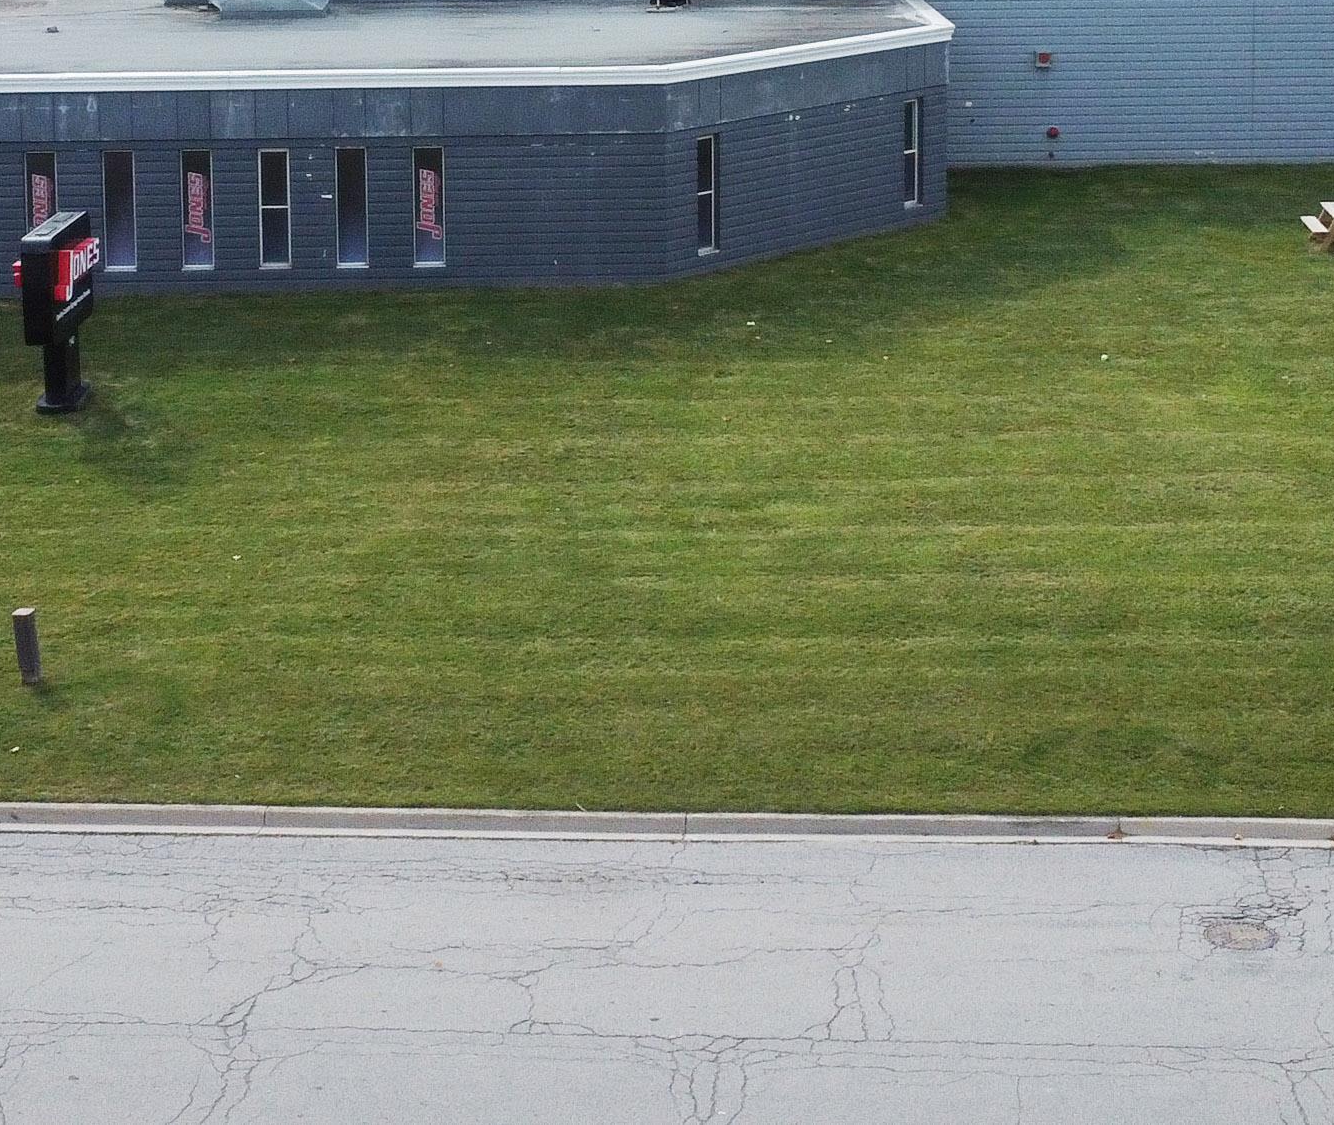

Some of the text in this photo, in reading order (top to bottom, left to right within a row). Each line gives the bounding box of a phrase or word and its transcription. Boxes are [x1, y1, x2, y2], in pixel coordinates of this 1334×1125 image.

[31, 174, 49, 230] ONES
[185, 172, 212, 244] JONES
[416, 168, 443, 240] JONES
[65, 237, 100, 302] JONES
